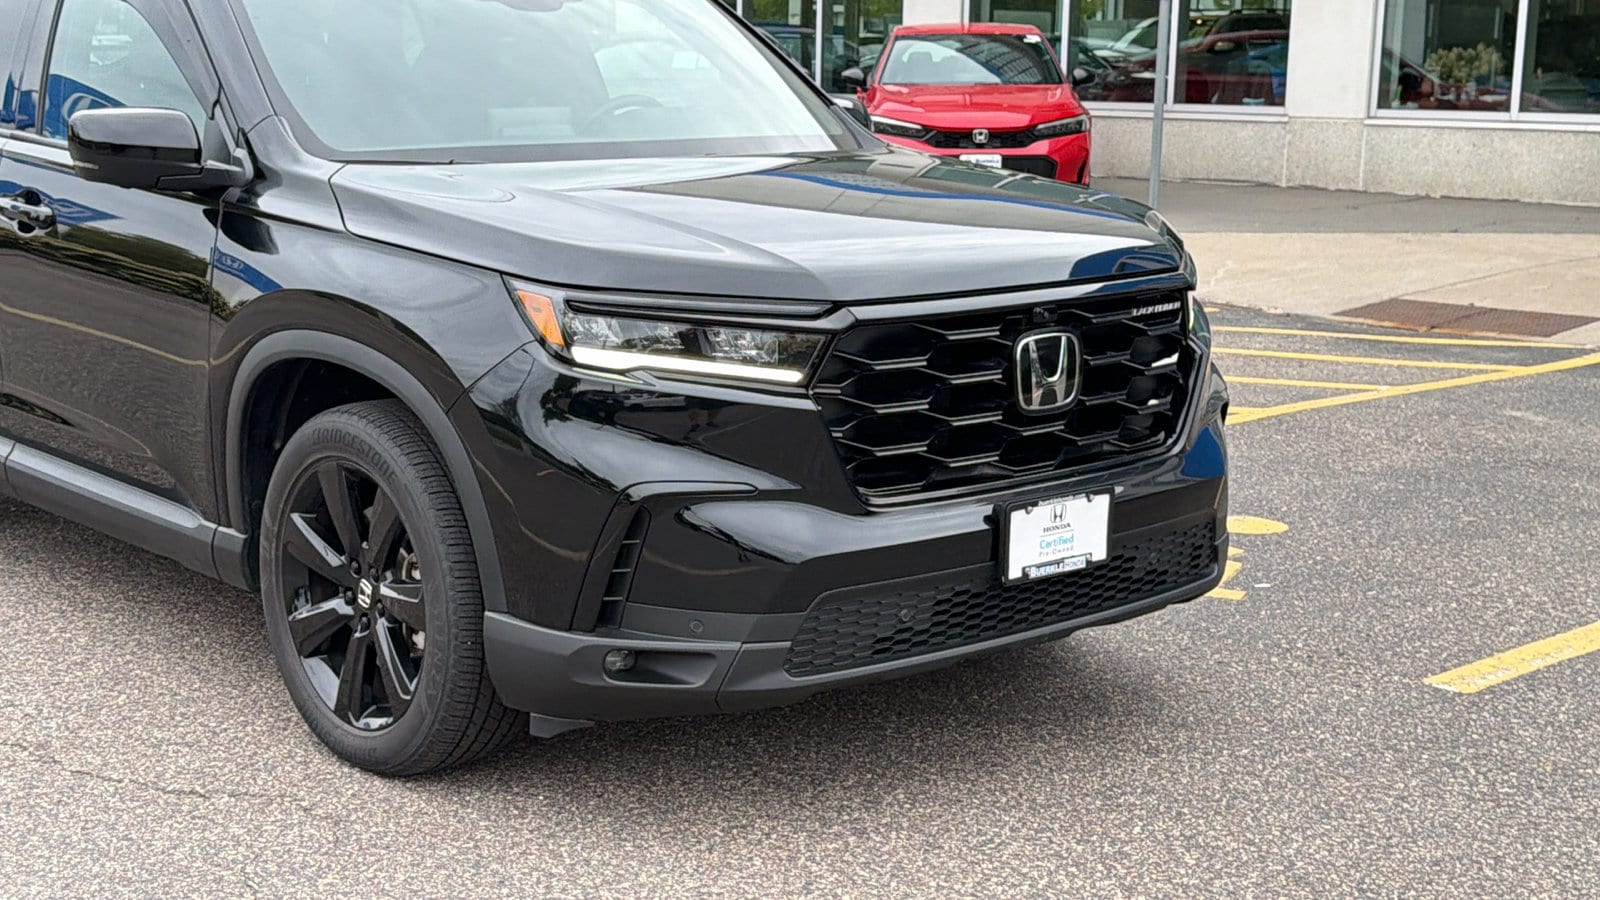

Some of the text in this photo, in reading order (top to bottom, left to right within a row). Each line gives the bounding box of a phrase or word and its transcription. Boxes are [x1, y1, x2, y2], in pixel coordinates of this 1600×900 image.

[311, 427, 400, 486] BRIDGESTONE
[1043, 522, 1071, 532] HONDA
[1040, 534, 1074, 549] Certified
